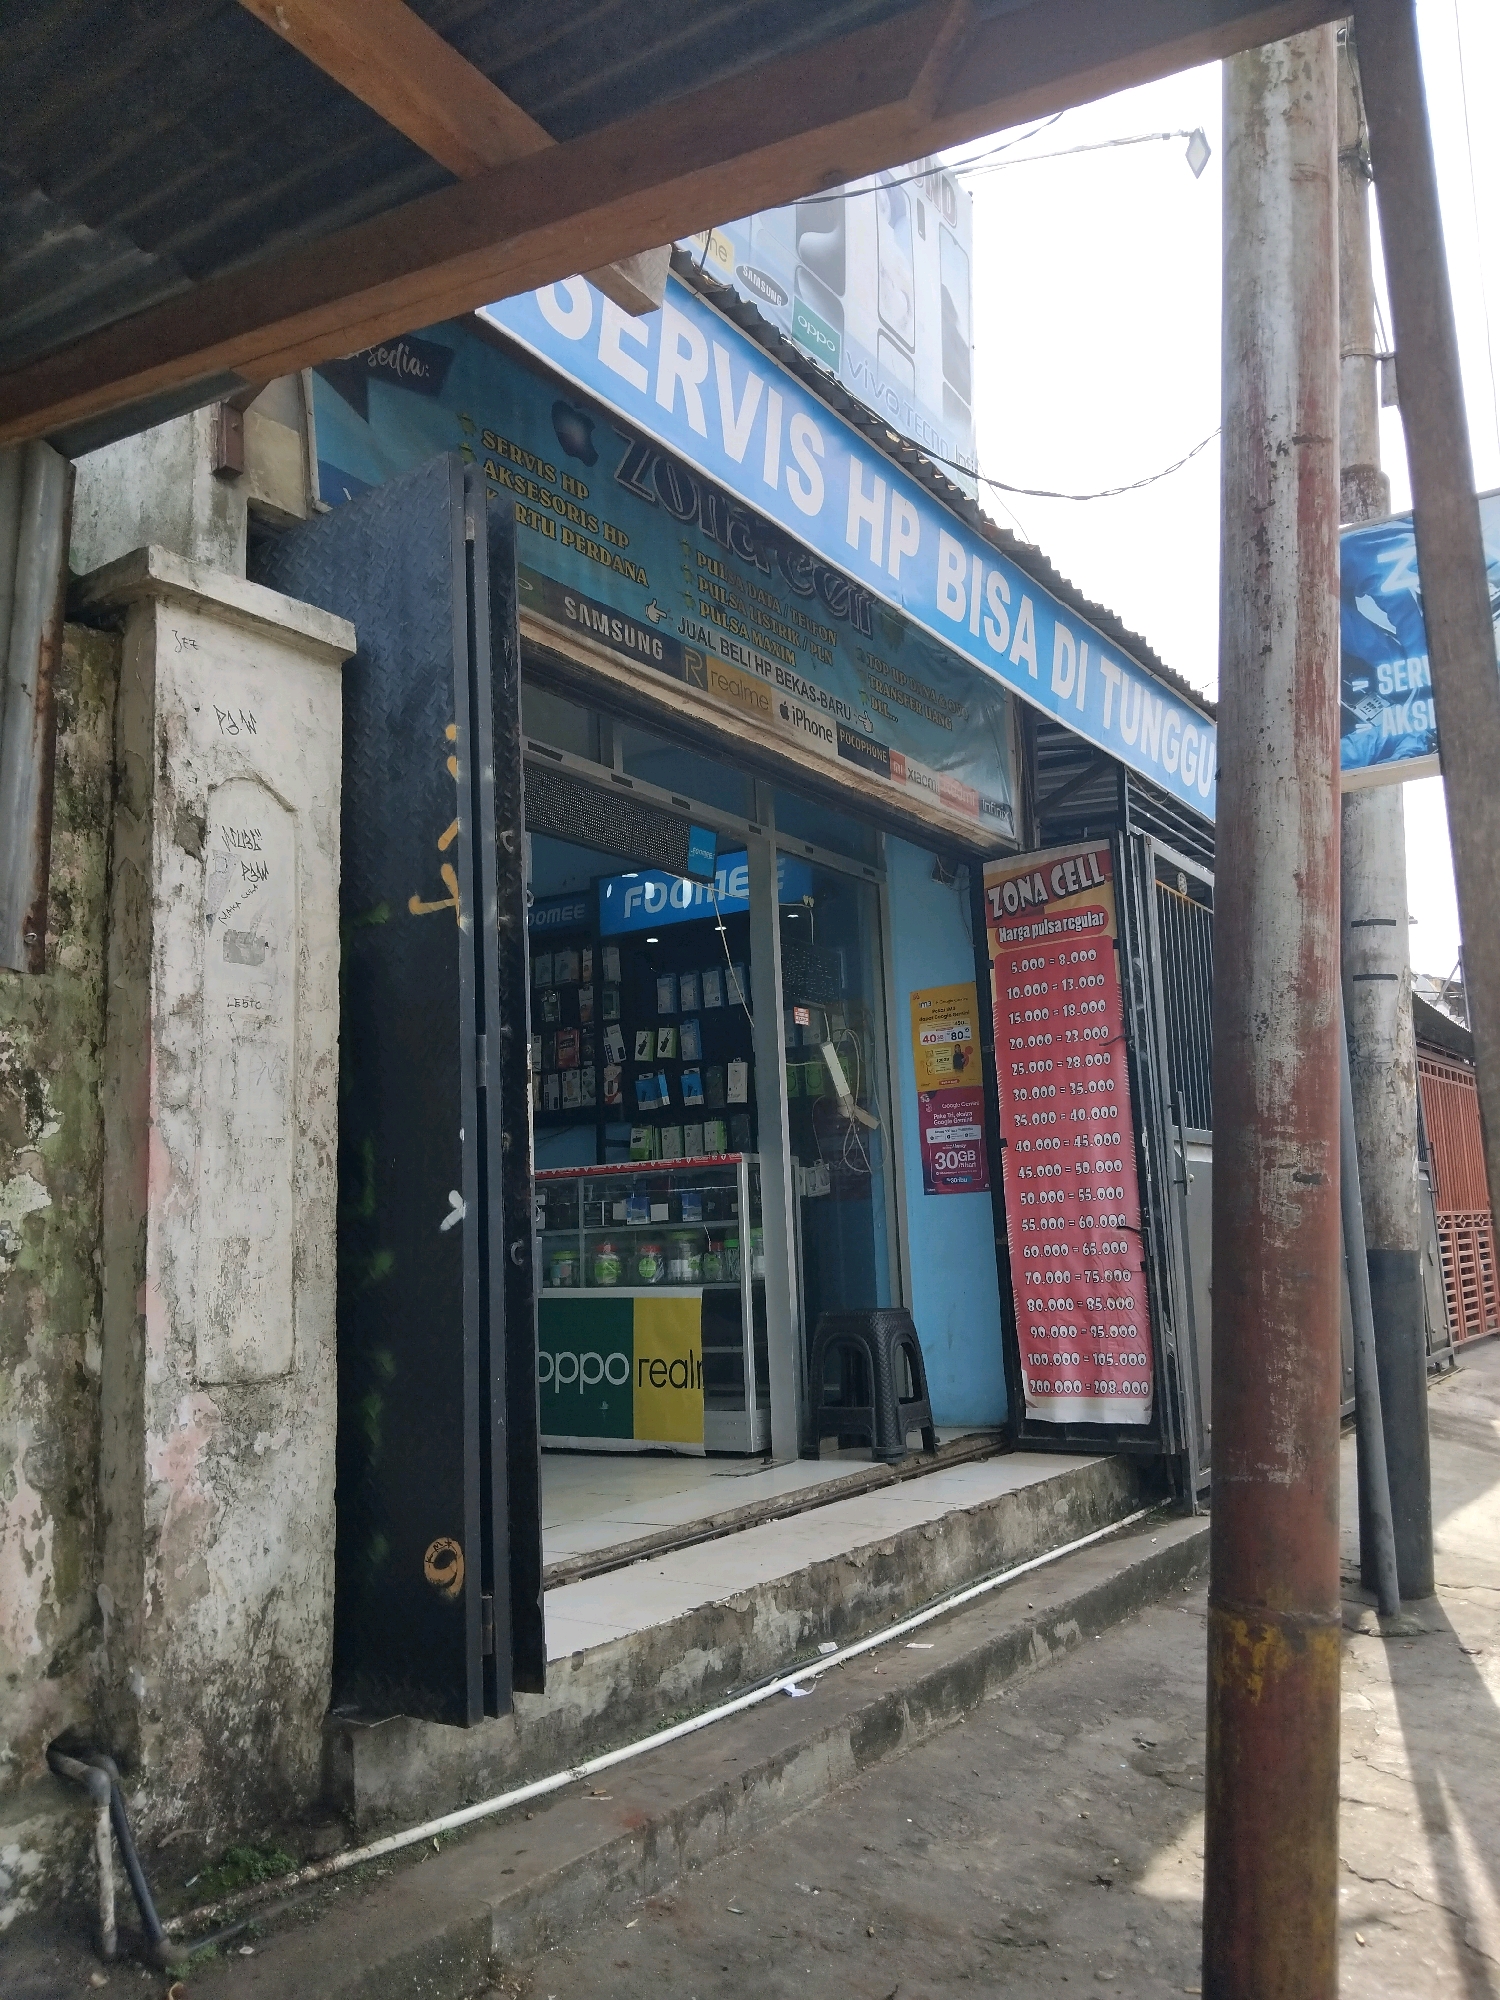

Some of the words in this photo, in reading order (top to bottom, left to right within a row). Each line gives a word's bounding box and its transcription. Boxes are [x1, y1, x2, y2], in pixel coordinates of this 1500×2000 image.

[742, 265, 783, 306] SAMSUNG
[798, 315, 836, 352] oppo
[366, 342, 430, 378] sedia:
[846, 351, 899, 414] vivo
[481, 429, 557, 483] SERVIS
[562, 474, 588, 500] HP
[484, 458, 598, 533] AKSESORIS
[603, 519, 629, 549] HP
[534, 274, 827, 516] SERVIS
[846, 450, 920, 579] HP
[935, 519, 1040, 680] BISA
[1051, 613, 1090, 713] DI
[1101, 644, 1216, 799] TUNGGU
[562, 526, 649, 588] PERDANA
[697, 551, 745, 597] PULSA
[748, 581, 781, 616] DATA
[564, 597, 662, 660] SAMSUNG
[697, 574, 746, 617] PULSA
[750, 607, 801, 650] LISTRIK
[809, 643, 833, 667] PLN
[699, 599, 750, 641] PULSA
[751, 628, 796, 667] MAXIM
[677, 616, 717, 652] JUAL
[720, 636, 751, 668] BELI
[755, 656, 772, 678] HP
[775, 666, 851, 720] BEKAS-BARU
[867, 651, 890, 676] TOP
[891, 666, 907, 686] UP
[711, 670, 769, 711] realme
[868, 673, 924, 717] TRANSFER
[924, 704, 953, 731] UANG
[792, 705, 833, 744] iPhone
[839, 729, 888, 763] POCOPHONE
[982, 798, 1010, 821] Infinix
[988, 872, 1049, 919] ZONA
[1051, 852, 1105, 898] CELL
[998, 924, 1031, 943] Harga
[1031, 918, 1064, 939] pulsa
[1064, 911, 1105, 932] regular
[1011, 957, 1045, 974] 5.000
[1058, 949, 1097, 966] 8.000
[1006, 982, 1048, 1000] 10.000
[1061, 974, 1105, 991] 13.000
[1008, 1008, 1049, 1025] 15.000
[1062, 999, 1106, 1017] 18.000
[951, 1031, 964, 1041] 80
[1009, 1033, 1053, 1050] 20.000
[1065, 1025, 1109, 1043] 23.000
[1011, 1059, 1053, 1076] 25.000
[1066, 1052, 1111, 1069] 28.000
[1013, 1084, 1056, 1101] 30.000
[1069, 1079, 1114, 1095] 35.000
[1014, 1111, 1057, 1127] 35.000
[1070, 1105, 1118, 1122] 40.000
[1015, 1137, 1061, 1153] 40.000
[1073, 1132, 1121, 1148] 45.000
[1018, 1163, 1062, 1179] 45.000
[1075, 1159, 1122, 1175] 50.000
[1020, 1190, 1065, 1205] 50.000
[1078, 1186, 1124, 1202] 55.000
[1021, 1217, 1065, 1232] 55.000
[1079, 1214, 1126, 1229] 60.000
[1023, 1243, 1069, 1258] 60.000
[1082, 1241, 1128, 1255] 65.000
[1025, 1270, 1071, 1285] 70.000
[1084, 1270, 1131, 1283] 75.000
[1026, 1298, 1074, 1312] 80.000
[1086, 1297, 1134, 1311] 85.000
[1030, 1325, 1078, 1338] 90.000
[1090, 1325, 1137, 1338] 95.000
[538, 1351, 630, 1394] oppo
[1027, 1351, 1080, 1366] 100.000
[1092, 1353, 1147, 1366] 105.000
[1030, 1379, 1082, 1393] 200.000
[1094, 1380, 1149, 1394] 208.000
